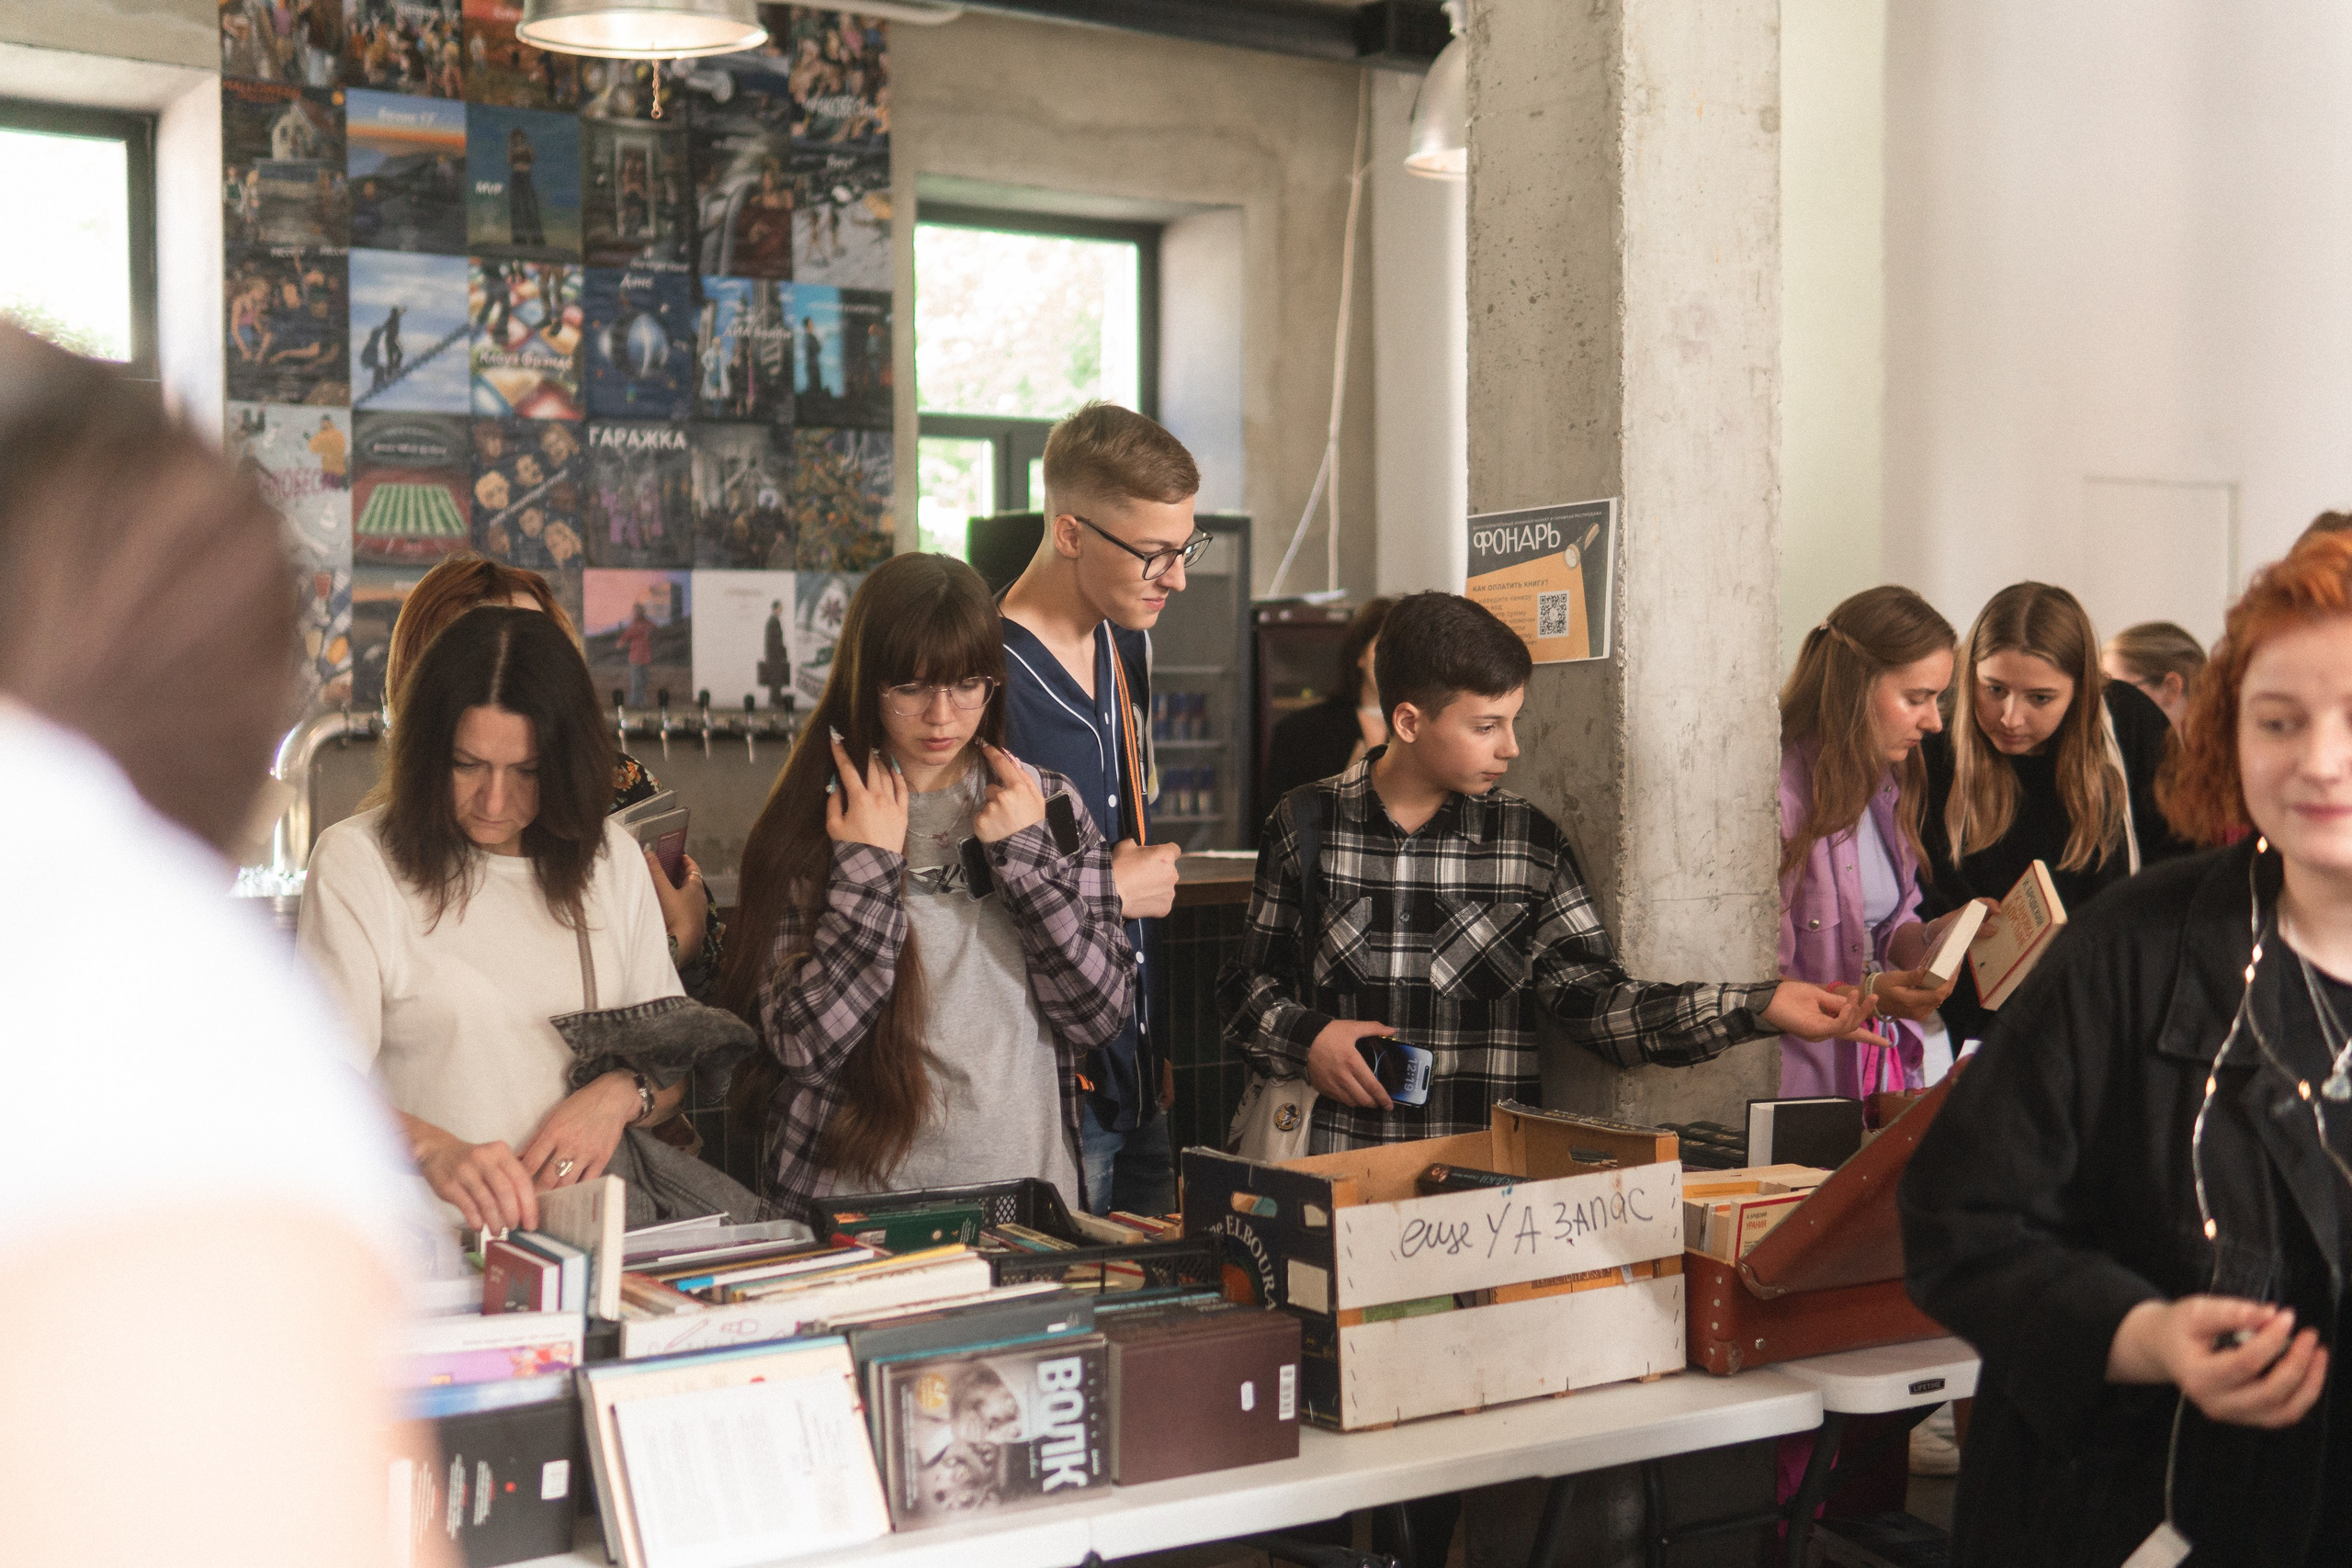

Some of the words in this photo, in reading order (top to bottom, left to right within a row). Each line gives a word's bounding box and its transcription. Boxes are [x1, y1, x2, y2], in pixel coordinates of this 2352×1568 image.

[588, 425, 688, 450] ГАРАЖКА
[1473, 522, 1561, 557] ФОНАРЬ
[1487, 581, 1522, 591] ОПЛАТИТЬ
[1523, 579, 1549, 587] КНИГУ?
[1404, 1058, 1418, 1092] 12:19
[1036, 1355, 1089, 1494] ВОЛК
